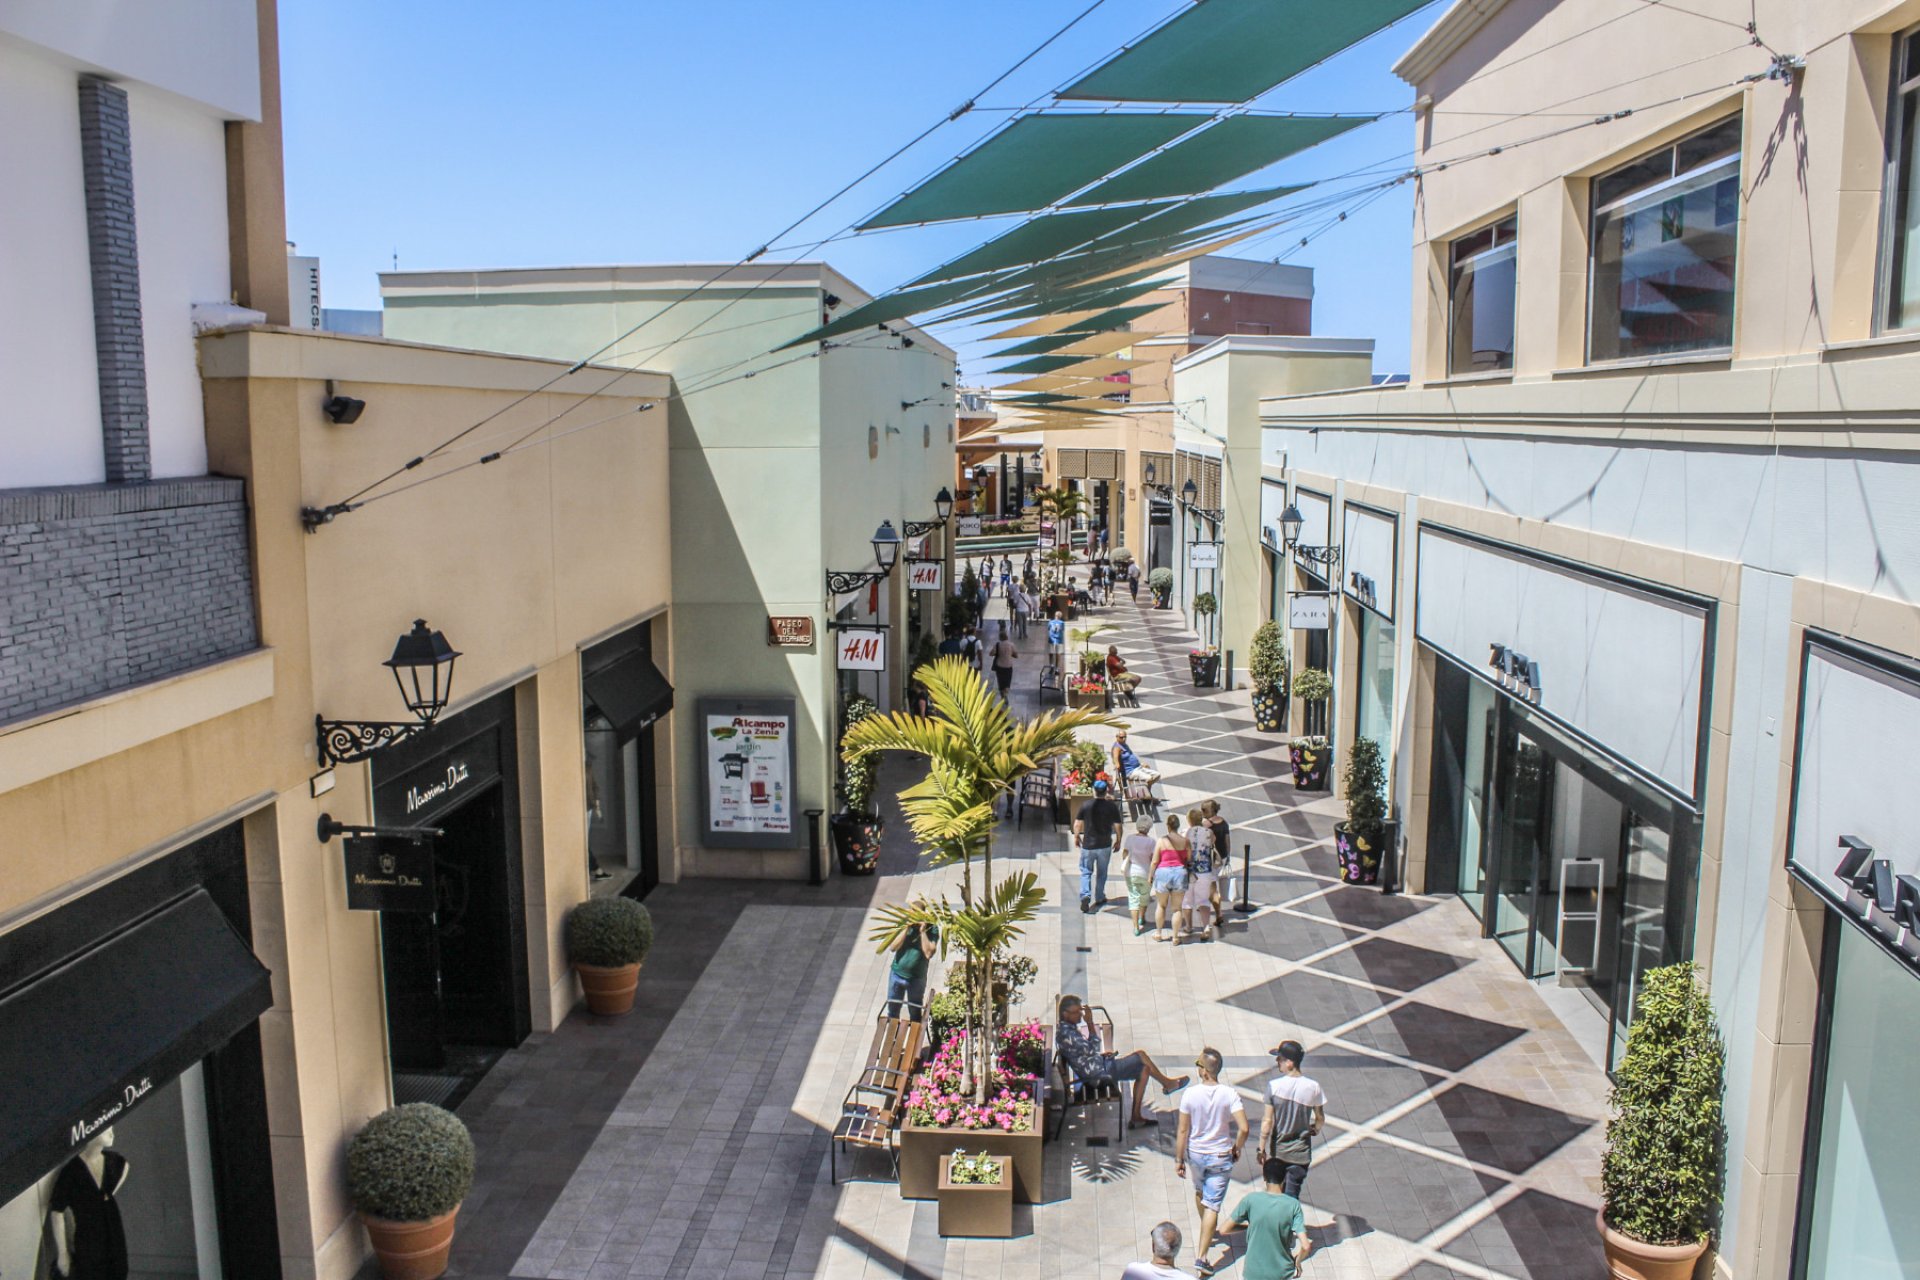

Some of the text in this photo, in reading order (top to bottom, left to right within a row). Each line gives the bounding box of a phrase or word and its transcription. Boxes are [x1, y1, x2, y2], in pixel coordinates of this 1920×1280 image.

[913, 567, 938, 585] H&M
[776, 619, 802, 628] PASEO
[782, 627, 798, 636] DEL
[843, 638, 879, 662] H&M
[731, 717, 786, 729] Alcampo
[754, 728, 780, 736] Zenia
[407, 763, 470, 814] Massimo Dutti
[71, 1077, 153, 1147] Massimo Dutti
